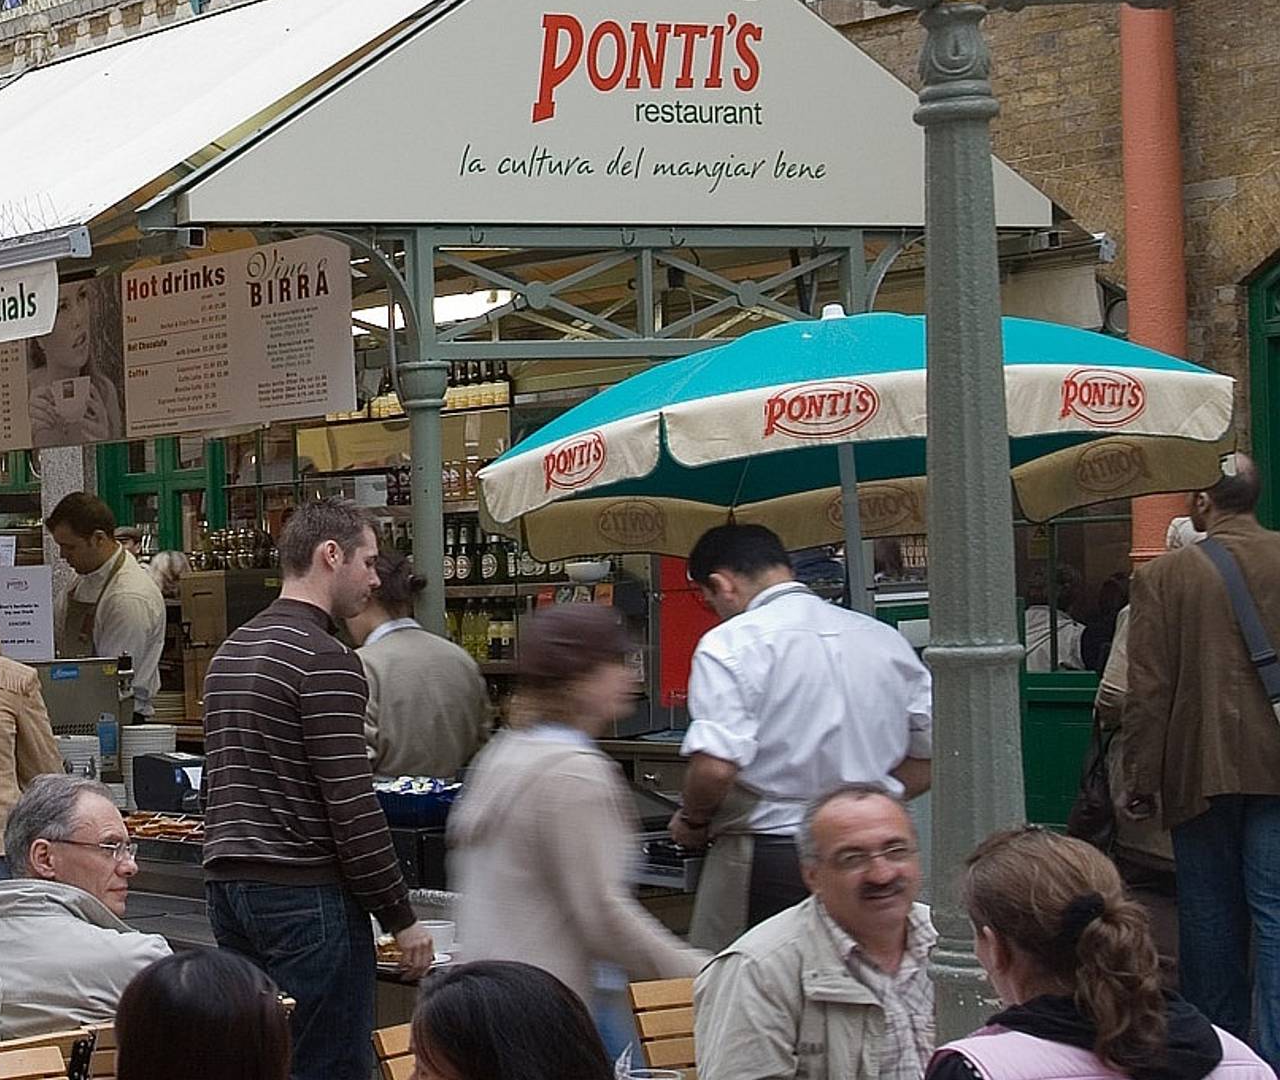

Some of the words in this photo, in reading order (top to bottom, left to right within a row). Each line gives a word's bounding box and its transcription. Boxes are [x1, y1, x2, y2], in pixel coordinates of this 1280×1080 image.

[532, 12, 763, 123] PONTI'S
[634, 100, 763, 125] restaurant
[459, 143, 486, 177] la
[497, 145, 594, 177] cultura
[606, 146, 645, 179] del
[653, 153, 766, 194] mangiar
[773, 150, 827, 181] bene
[127, 275, 158, 301] Hot
[162, 265, 225, 295] drinks
[246, 270, 329, 307] BIRRA
[763, 386, 871, 440] PONTI'S
[1060, 379, 1142, 420] PONTI'S
[544, 437, 604, 494] PONTI'S
